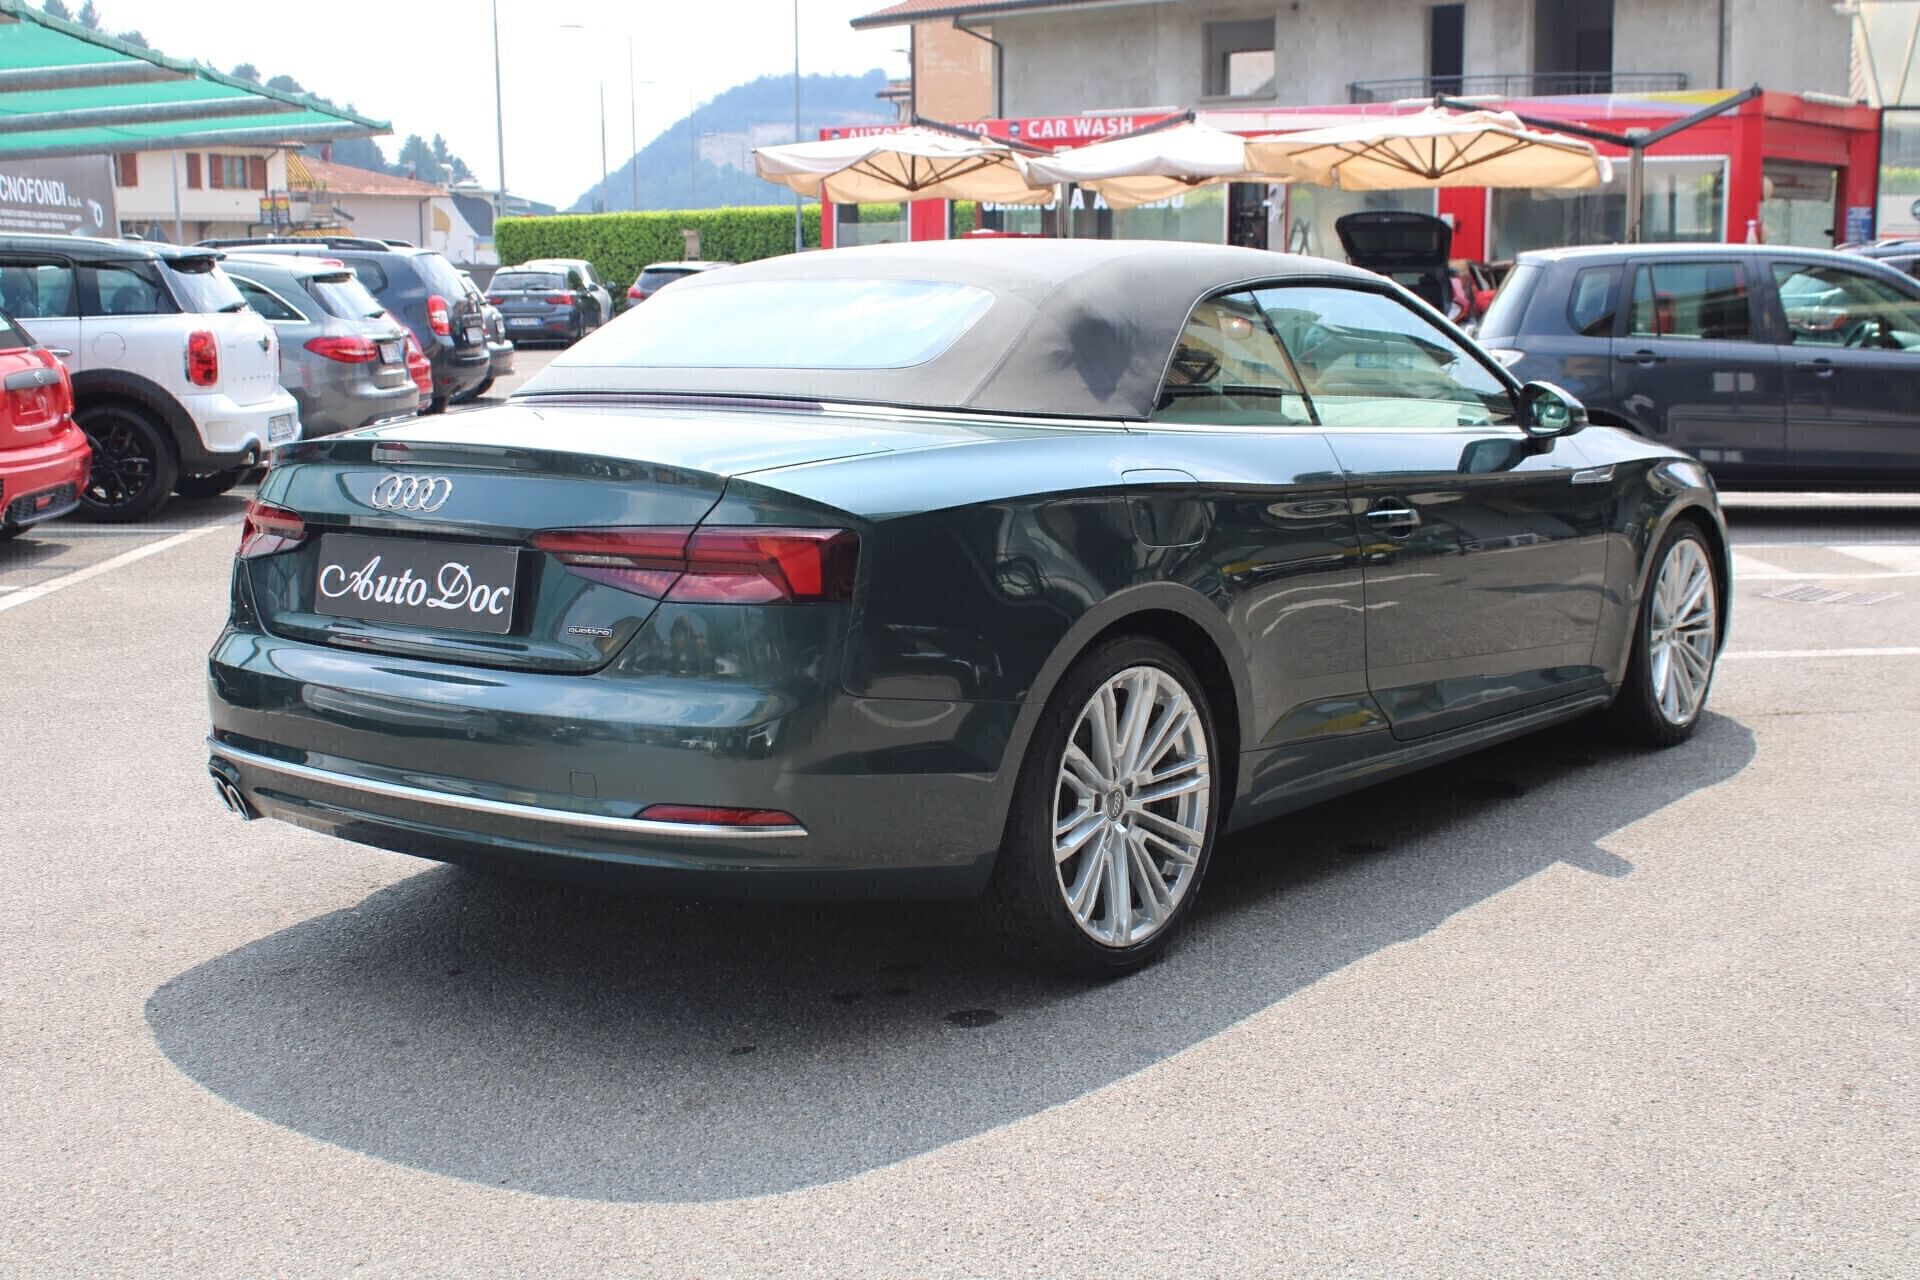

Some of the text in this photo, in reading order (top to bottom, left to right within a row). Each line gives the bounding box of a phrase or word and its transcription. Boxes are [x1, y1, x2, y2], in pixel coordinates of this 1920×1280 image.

[1027, 117, 1134, 138] CAR WASH
[568, 627, 610, 636] quattro
